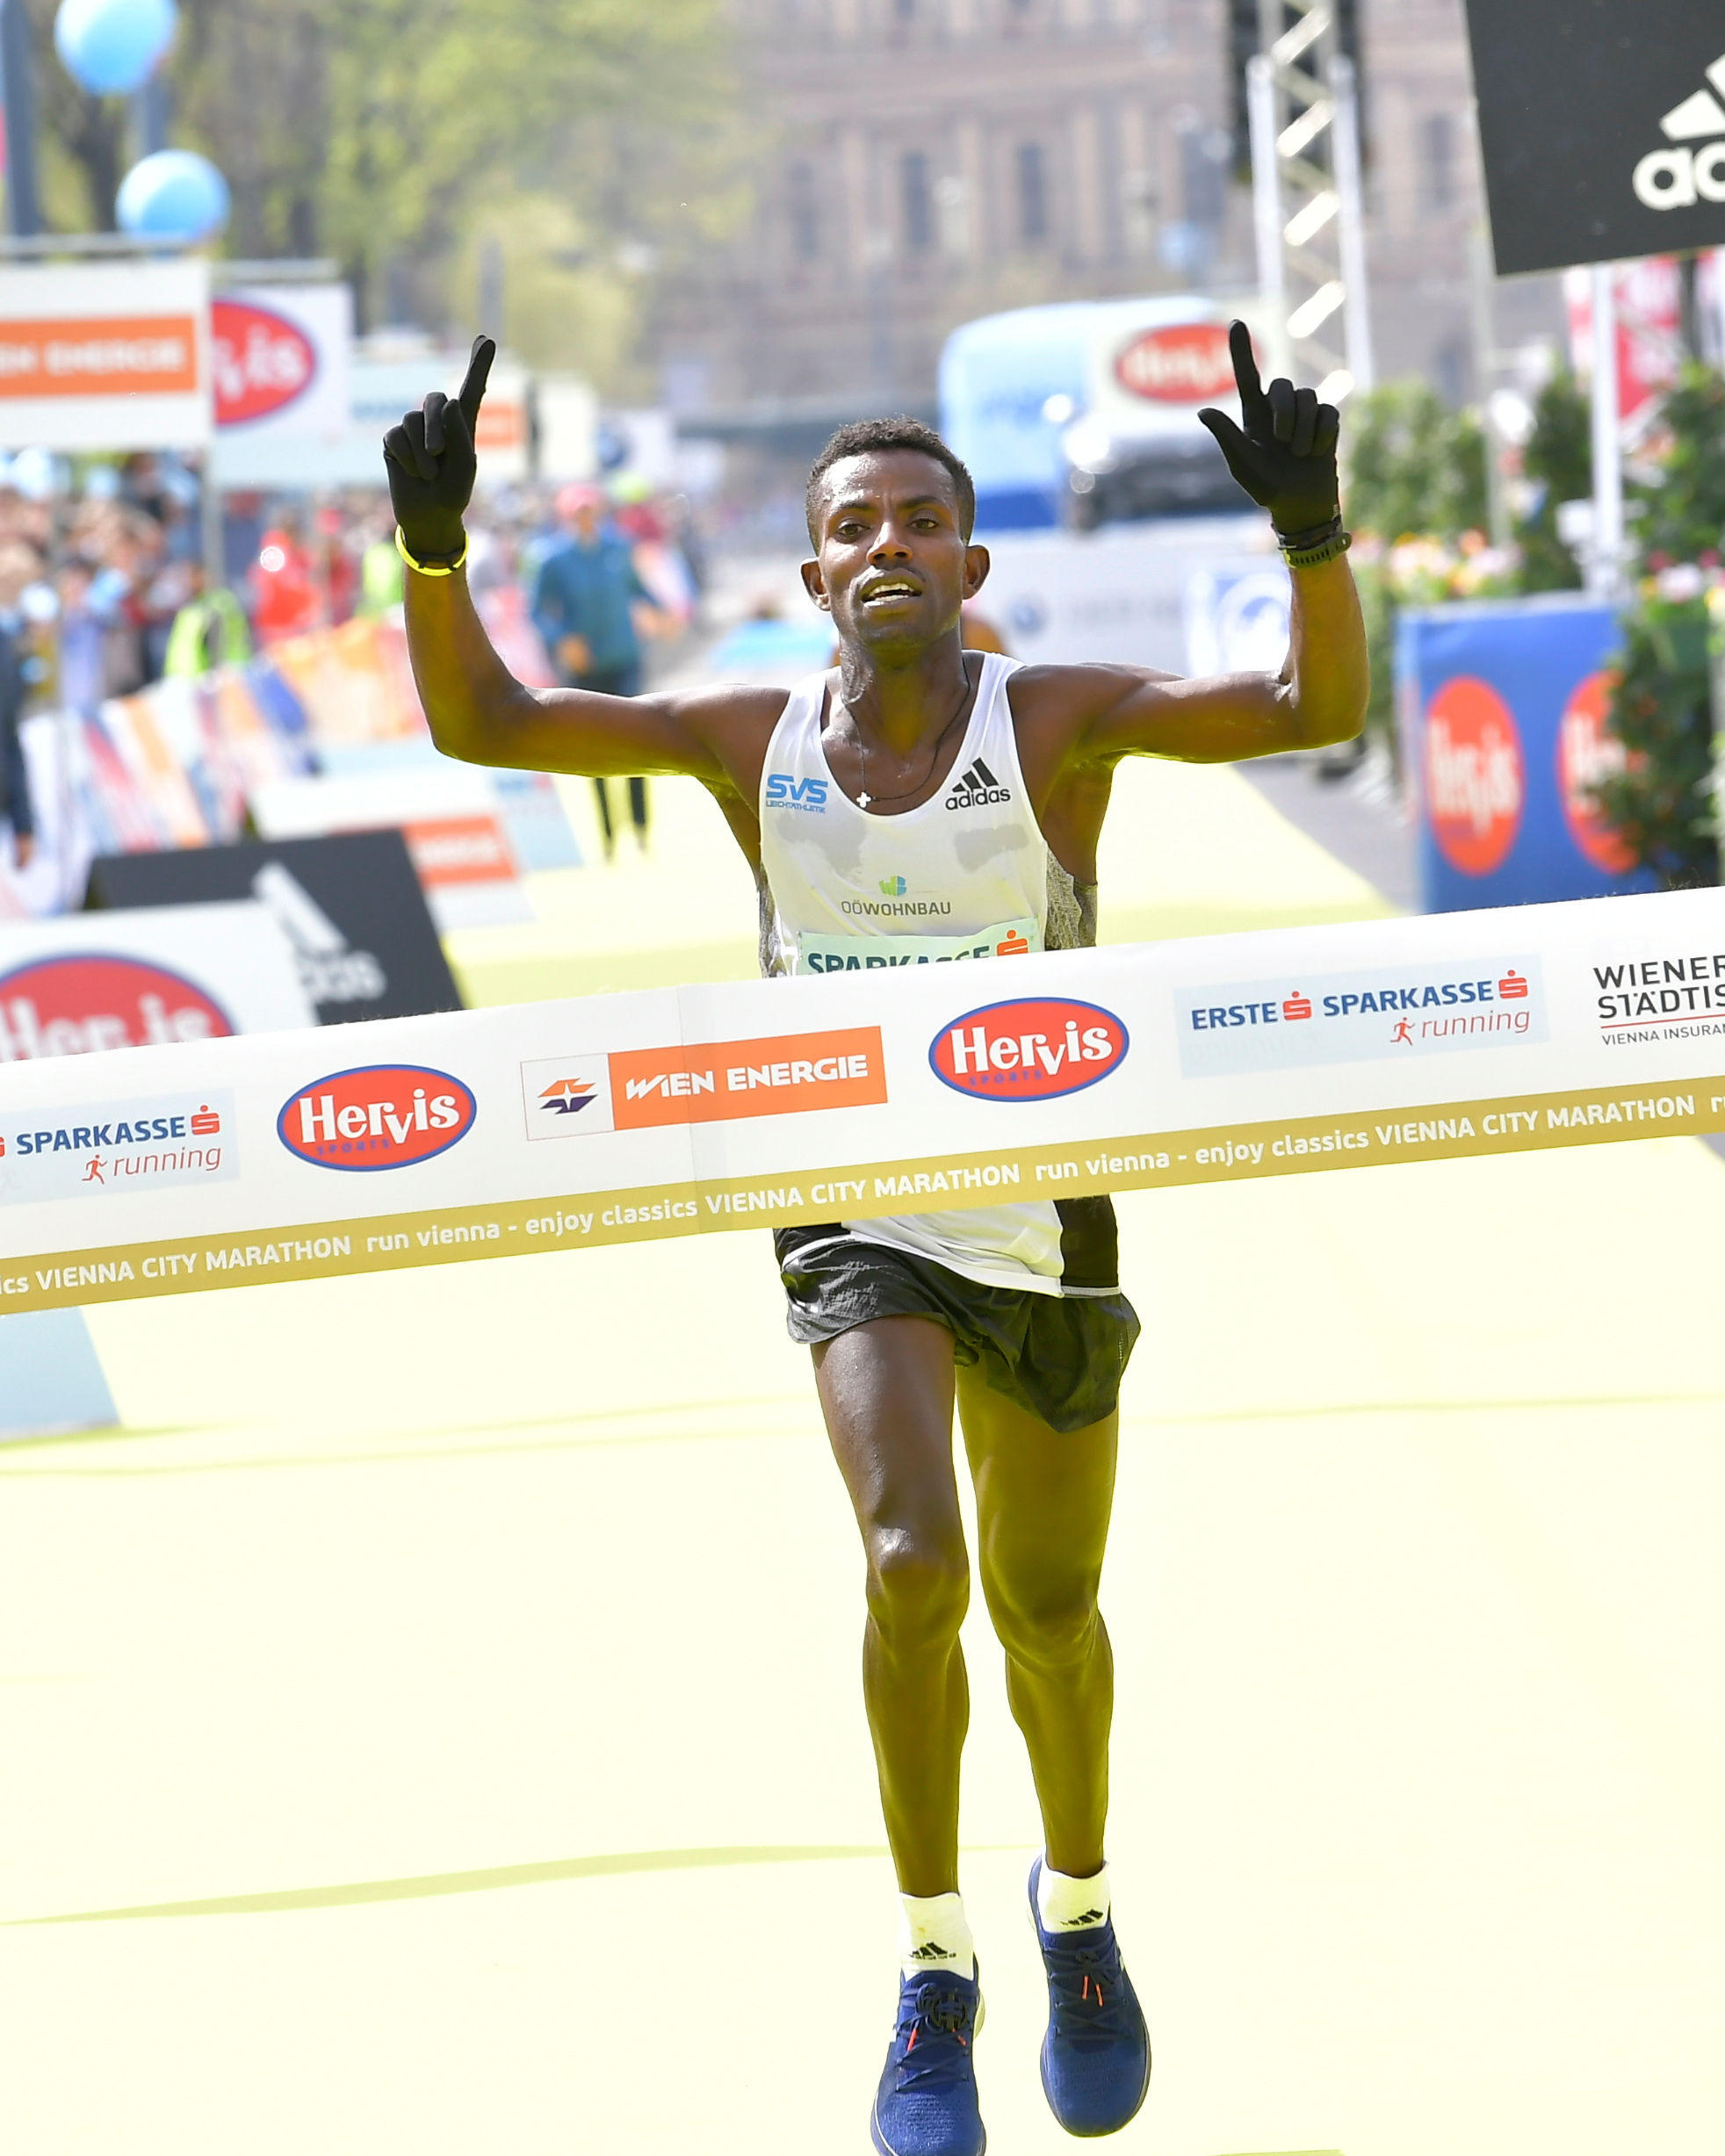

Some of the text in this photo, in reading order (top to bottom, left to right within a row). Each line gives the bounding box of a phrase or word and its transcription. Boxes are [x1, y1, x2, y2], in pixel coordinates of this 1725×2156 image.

[766, 774, 828, 804] SVS
[945, 788, 1011, 811] adidas
[1592, 954, 1725, 990] WIENER
[1191, 979, 1495, 1030] ERSTE SPARKASSE
[1421, 1009, 1531, 1037] running
[950, 1020, 1113, 1076] Hervis
[1601, 1029, 1660, 1046] VIENNA
[625, 1054, 869, 1100] WIEN ENERGIE
[16, 1115, 186, 1155] SPARKASSE
[299, 1089, 460, 1143] Hervis
[113, 1145, 222, 1177] running
[35, 1260, 135, 1290] VIENNA
[141, 1252, 198, 1278] CITY
[206, 1236, 351, 1272] MARATHON
[366, 1233, 409, 1252] run
[416, 1222, 501, 1247] vienna
[525, 1211, 594, 1237] enjoy
[602, 1199, 698, 1226] classics
[704, 1186, 805, 1215] VIENNA
[811, 1179, 867, 1205] CITY
[874, 1163, 1021, 1198] MARATHON
[1035, 1162, 1079, 1181] run
[1085, 1152, 1170, 1176] vienna
[1195, 1140, 1264, 1167] enjoy
[1272, 1129, 1369, 1157] classics
[1375, 1117, 1476, 1145] VIENNA
[1483, 1110, 1539, 1136] CITY
[1547, 1094, 1695, 1129] MARATHON
[1711, 1096, 1725, 1113] r
